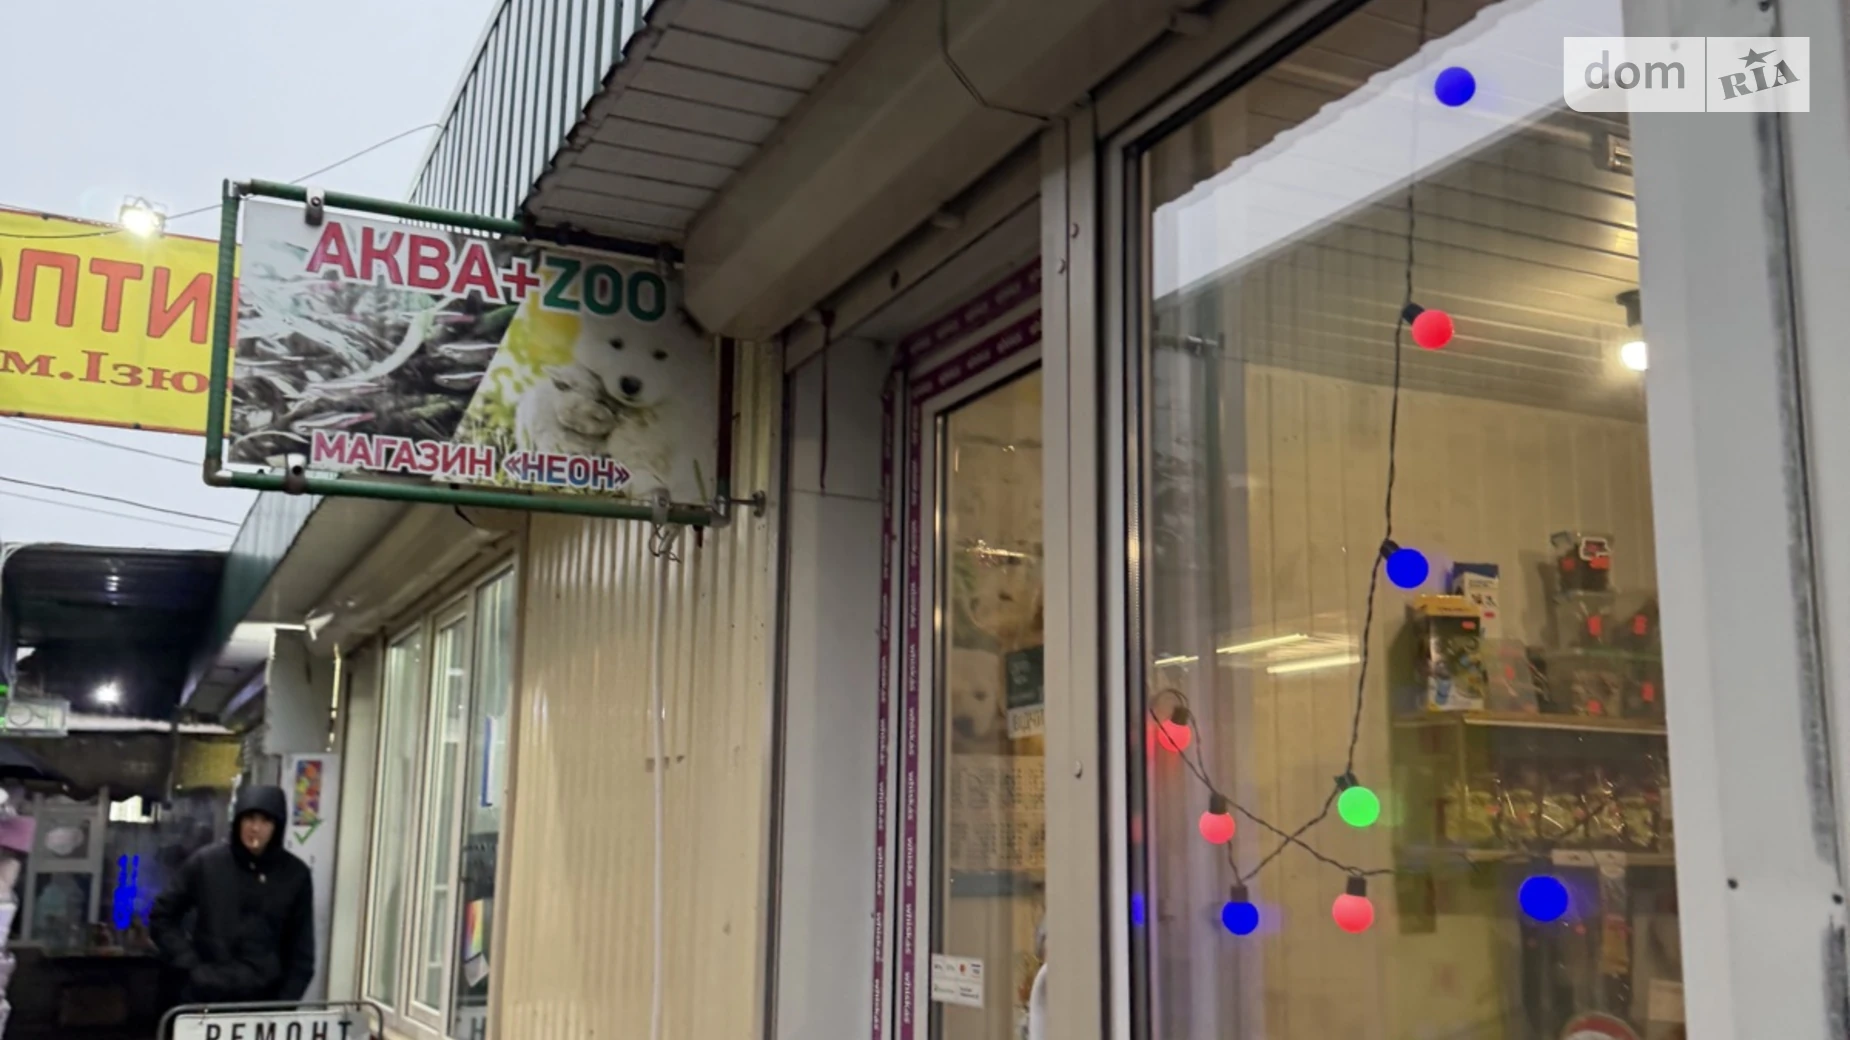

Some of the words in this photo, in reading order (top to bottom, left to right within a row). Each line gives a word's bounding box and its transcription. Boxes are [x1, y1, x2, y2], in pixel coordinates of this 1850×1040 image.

[0, 248, 239, 348] ПТИ
[0, 349, 234, 395] м.Ізю
[313, 431, 494, 478] МАГАЗИН
[504, 451, 631, 489] «НЕОН»
